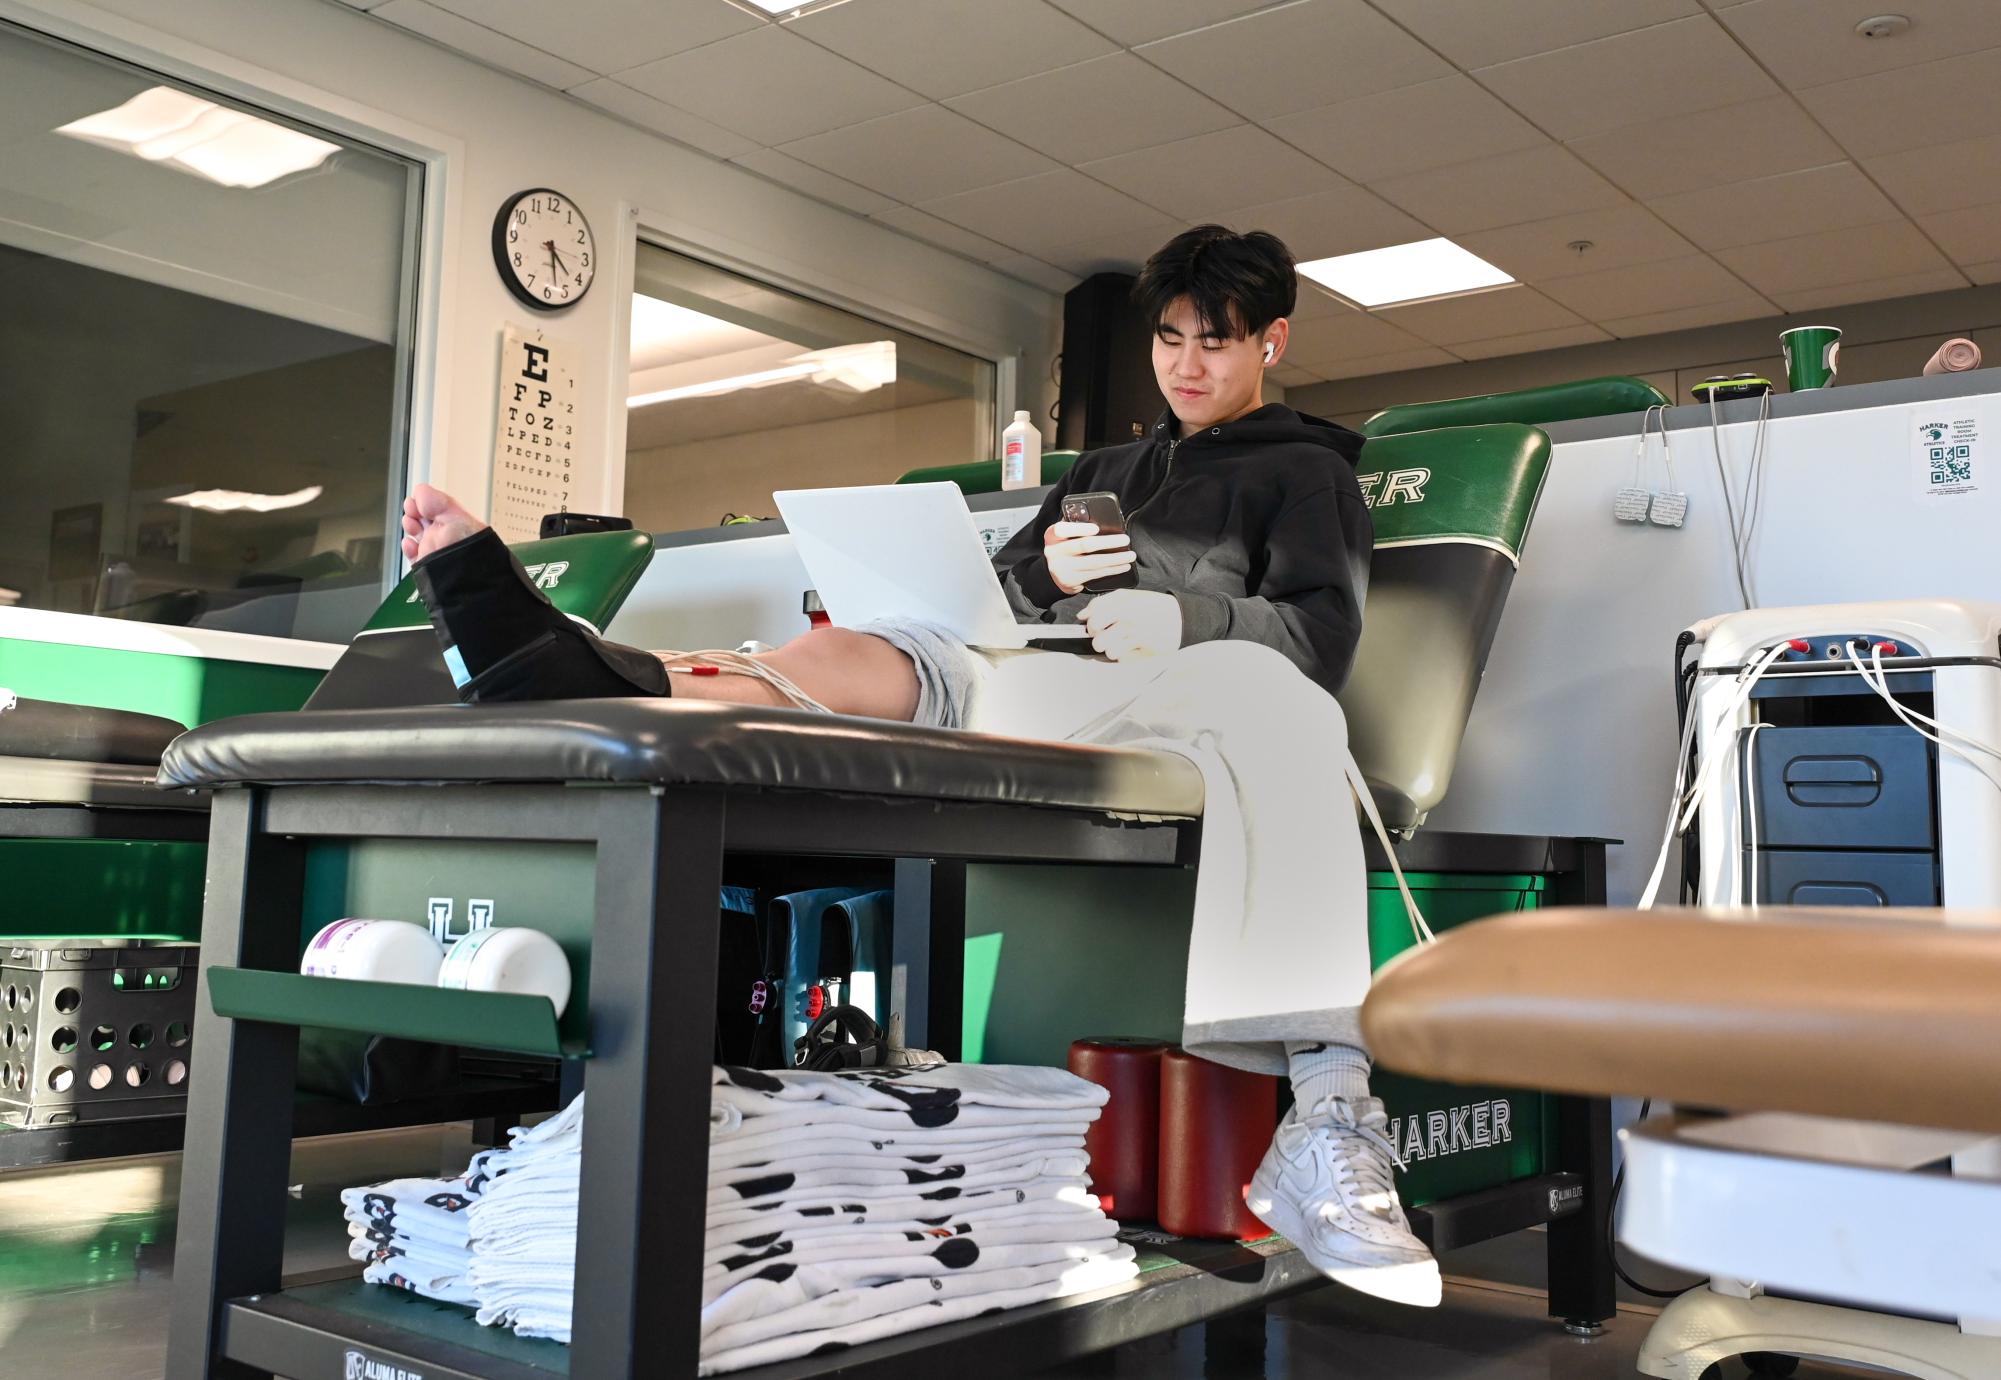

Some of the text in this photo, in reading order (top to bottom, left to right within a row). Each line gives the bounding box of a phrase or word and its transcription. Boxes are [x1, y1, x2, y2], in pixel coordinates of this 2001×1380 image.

[531, 197, 561, 214] 11 12
[515, 209, 527, 225] 10
[567, 210, 572, 224] 1
[509, 230, 518, 243] 9
[577, 229, 585, 244] 2
[514, 252, 522, 267] 8
[581, 252, 589, 267] 3
[527, 273, 535, 288] 7
[574, 272, 583, 286] 4
[543, 287, 552, 299] 6
[560, 284, 569, 299] 5
[522, 342, 549, 383] E
[569, 379, 573, 388] 1
[513, 382, 552, 408] F P
[567, 404, 573, 413] 2
[566, 425, 572, 435] 3
[1920, 423, 1948, 432] HARKER
[564, 441, 571, 450] 4
[564, 458, 571, 467] 5
[563, 473, 569, 483] 6
[562, 492, 568, 501] 7
[560, 504, 567, 513] 8
[364, 1360, 395, 1380] ALUMA
